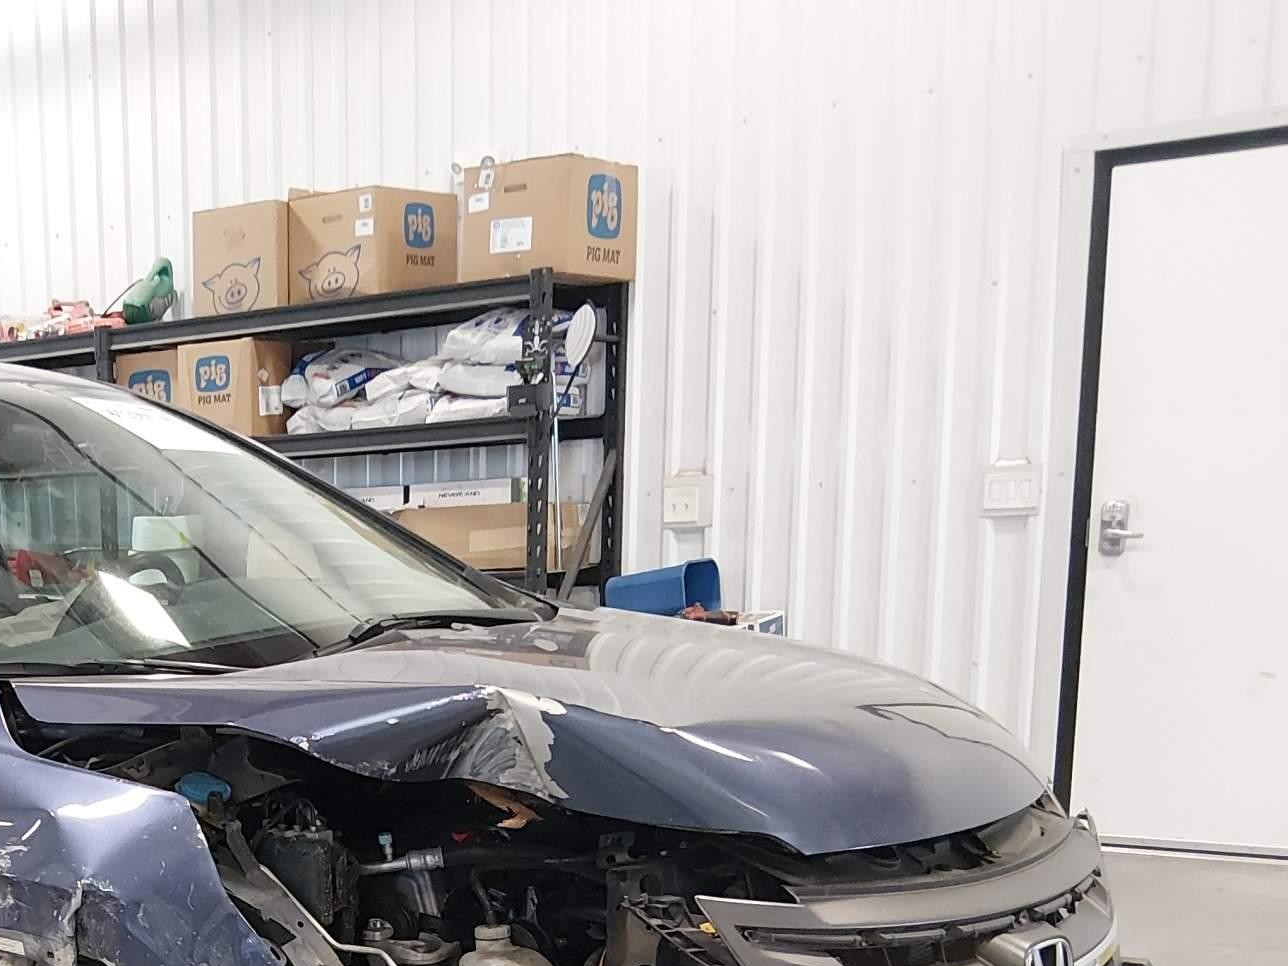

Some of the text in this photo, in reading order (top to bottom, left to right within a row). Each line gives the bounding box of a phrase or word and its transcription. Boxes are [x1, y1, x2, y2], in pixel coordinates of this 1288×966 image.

[590, 182, 618, 231] pig
[407, 208, 432, 242] pig
[406, 254, 436, 267] PIG MAT
[586, 246, 621, 265] PIG MAT
[199, 359, 227, 388] pig
[198, 393, 232, 405] PIG MAT
